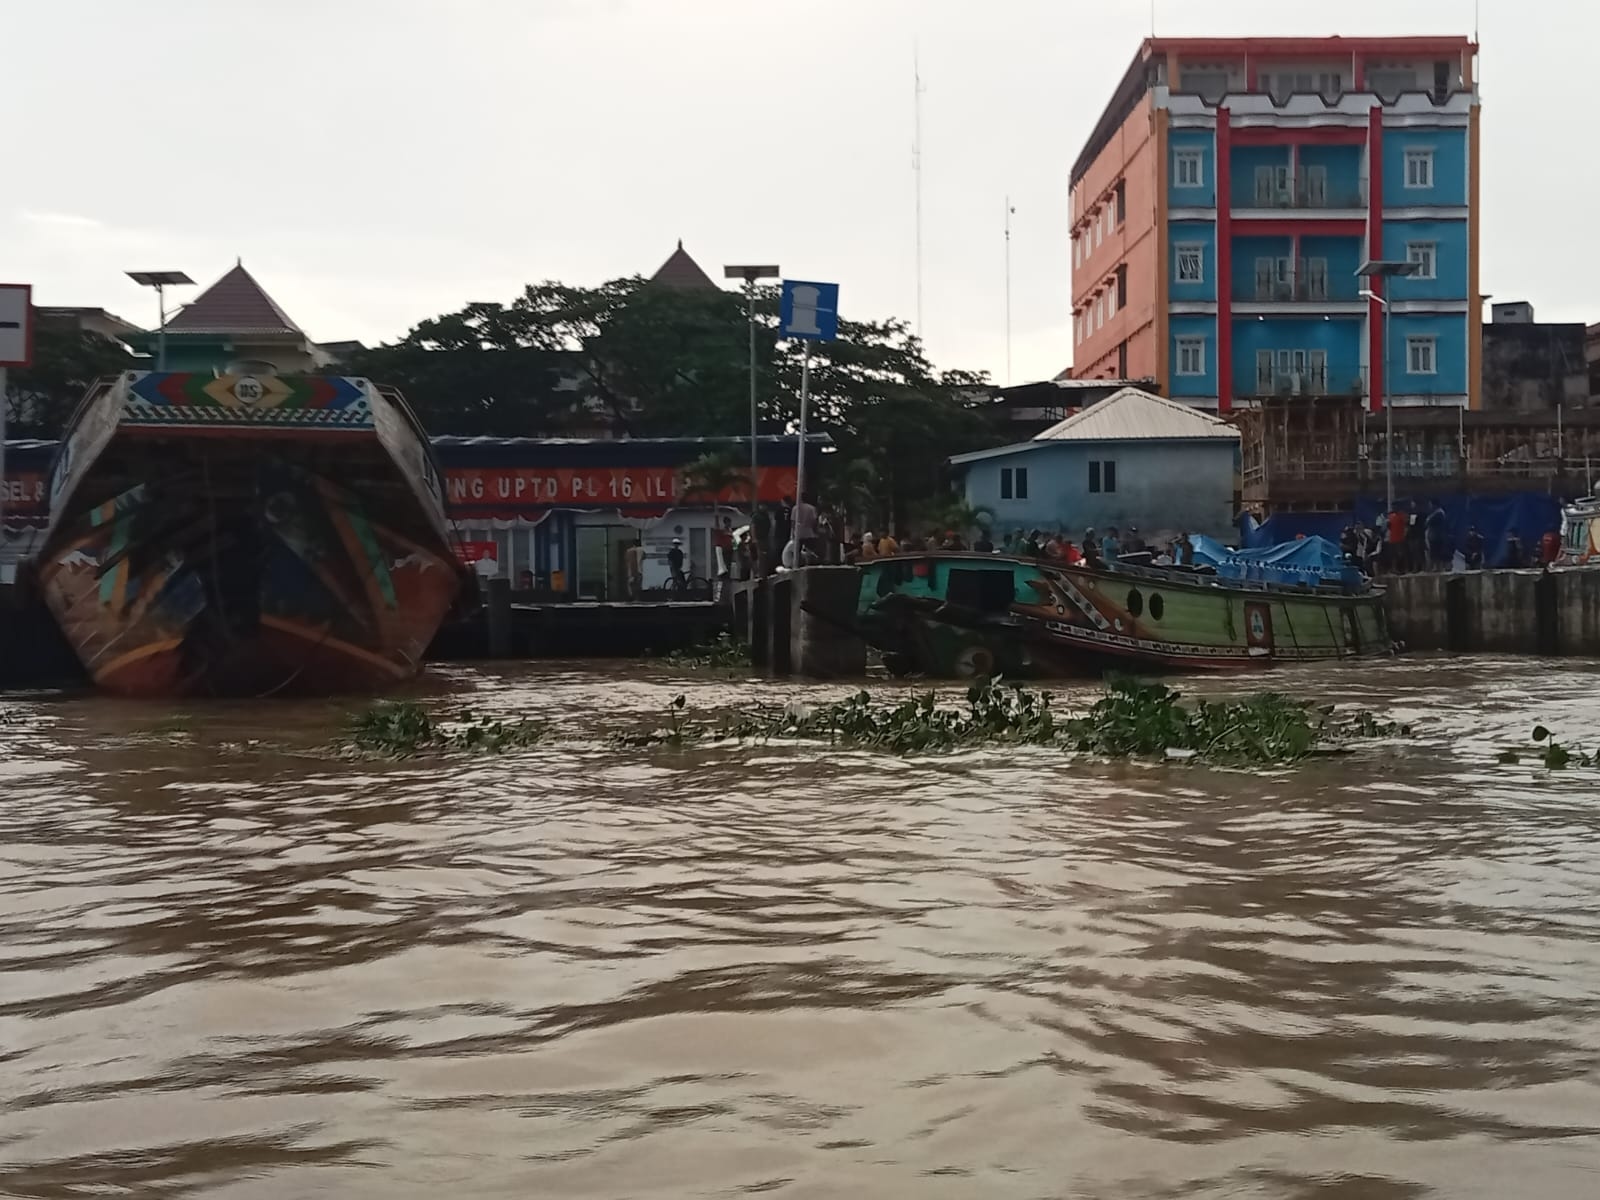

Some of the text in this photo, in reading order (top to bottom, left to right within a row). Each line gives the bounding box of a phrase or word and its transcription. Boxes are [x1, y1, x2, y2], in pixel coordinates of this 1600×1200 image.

[497, 477, 558, 498] UPTD
[572, 476, 598, 498] PL
[608, 476, 633, 498] 16
